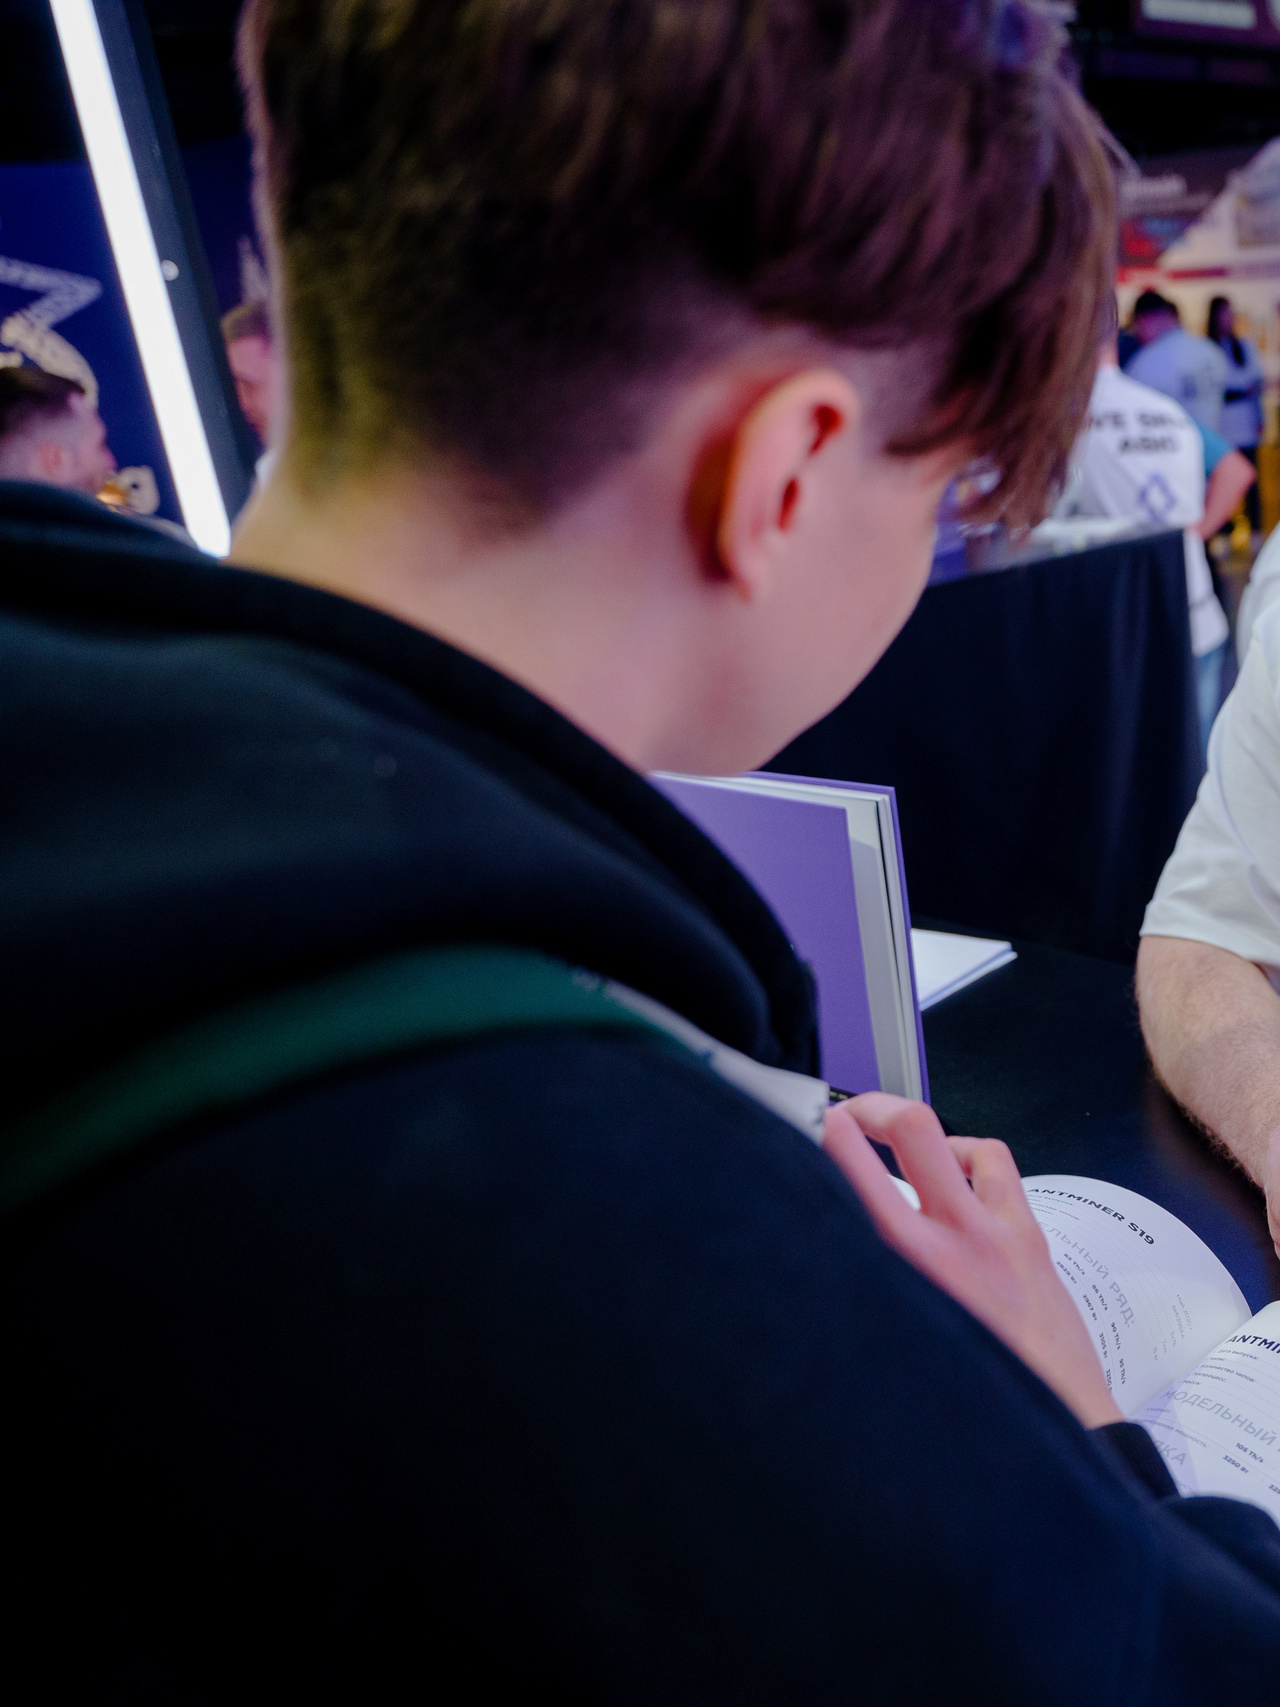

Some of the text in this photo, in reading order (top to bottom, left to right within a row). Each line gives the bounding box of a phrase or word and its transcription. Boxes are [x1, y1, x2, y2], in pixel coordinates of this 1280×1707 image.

[1027, 1188, 1155, 1245] ANTMINER S19
[1039, 1221, 1109, 1279] ЕЛЬНЫЙ
[1109, 1281, 1134, 1328] РЯД:
[1160, 1390, 1278, 1446] МОДЕЛЬНЫЙ
[1235, 1442, 1249, 1453] 105
[1248, 1450, 1264, 1463] Th/s
